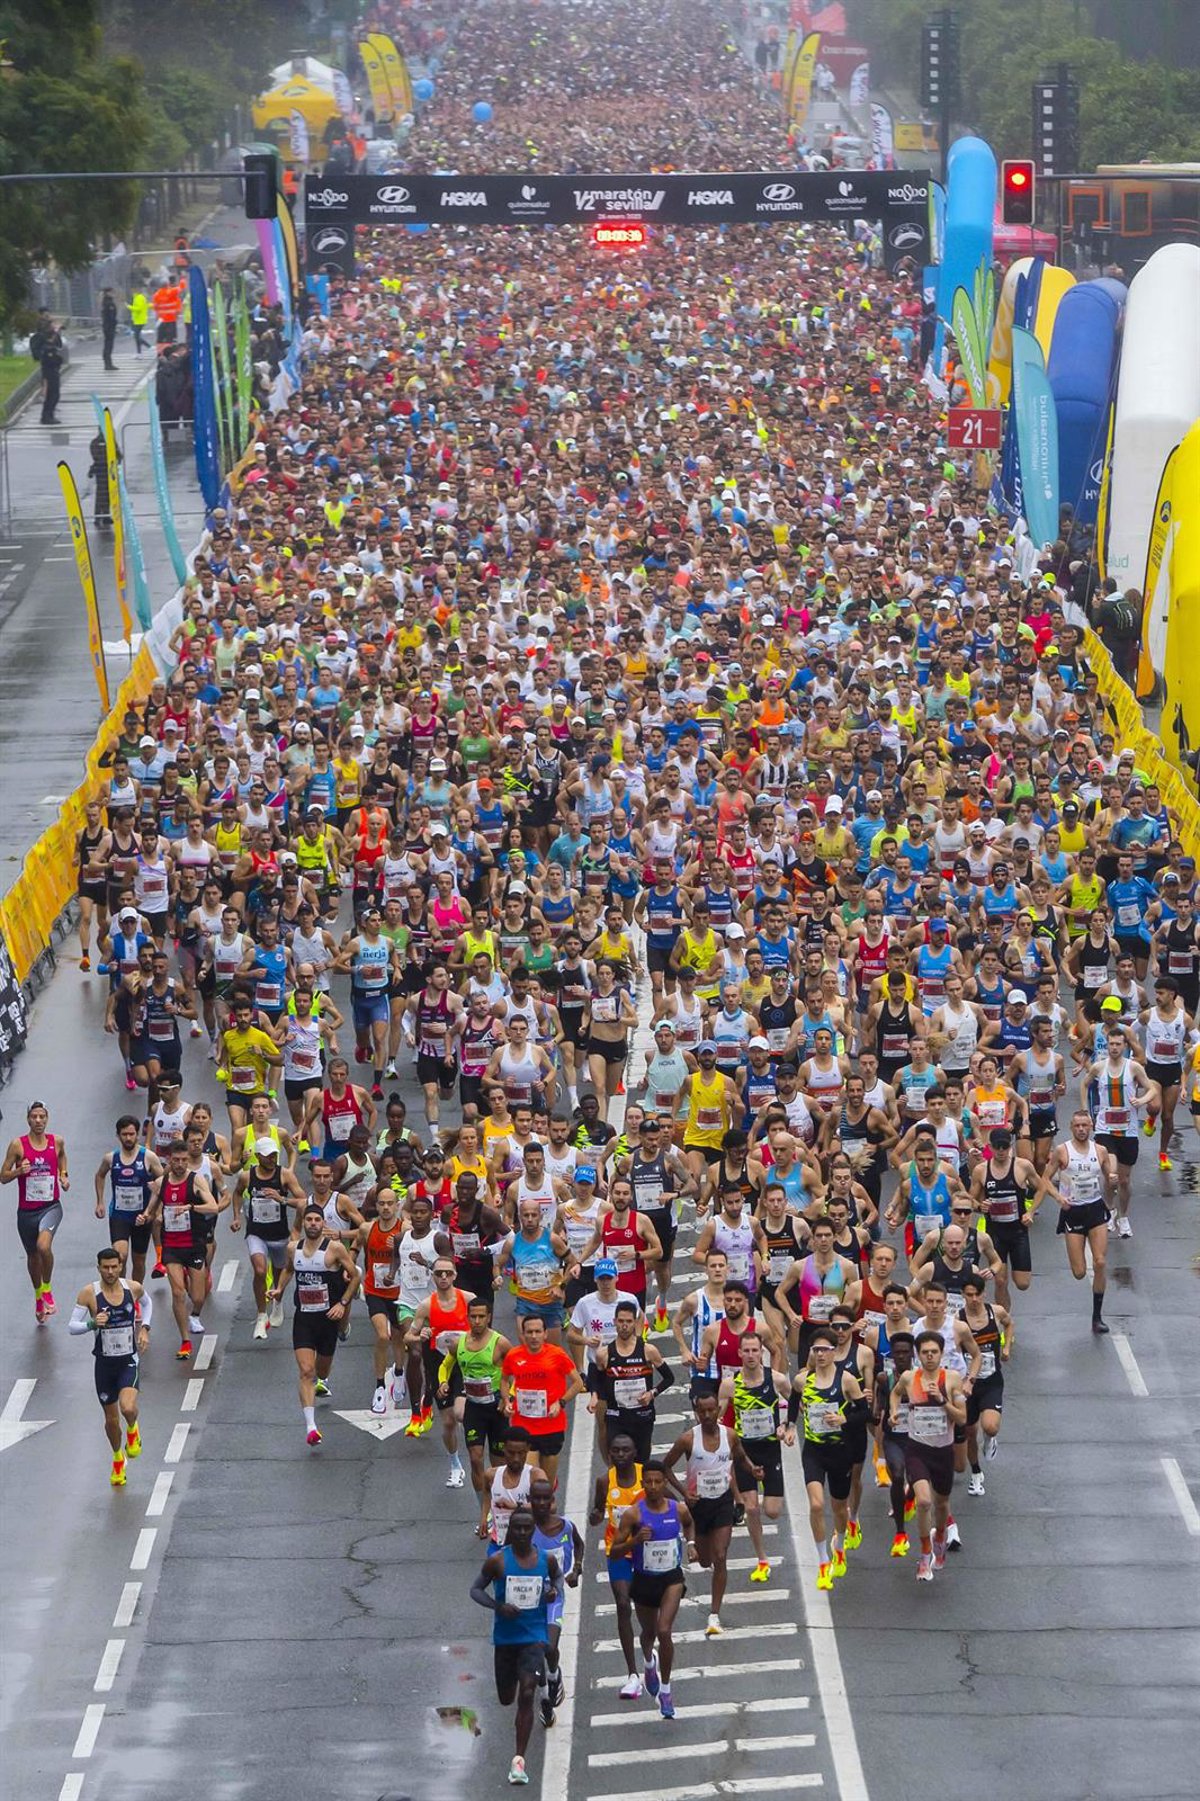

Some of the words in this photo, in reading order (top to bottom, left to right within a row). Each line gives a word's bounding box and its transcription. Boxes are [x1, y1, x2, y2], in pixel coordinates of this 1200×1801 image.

[441, 191, 488, 206] HOKA
[687, 190, 735, 206] HOKA
[369, 204, 417, 213] HYUNDAI
[605, 200, 651, 211] sevilla
[756, 202, 804, 212] HYUNDAI
[963, 418, 982, 444] 21
